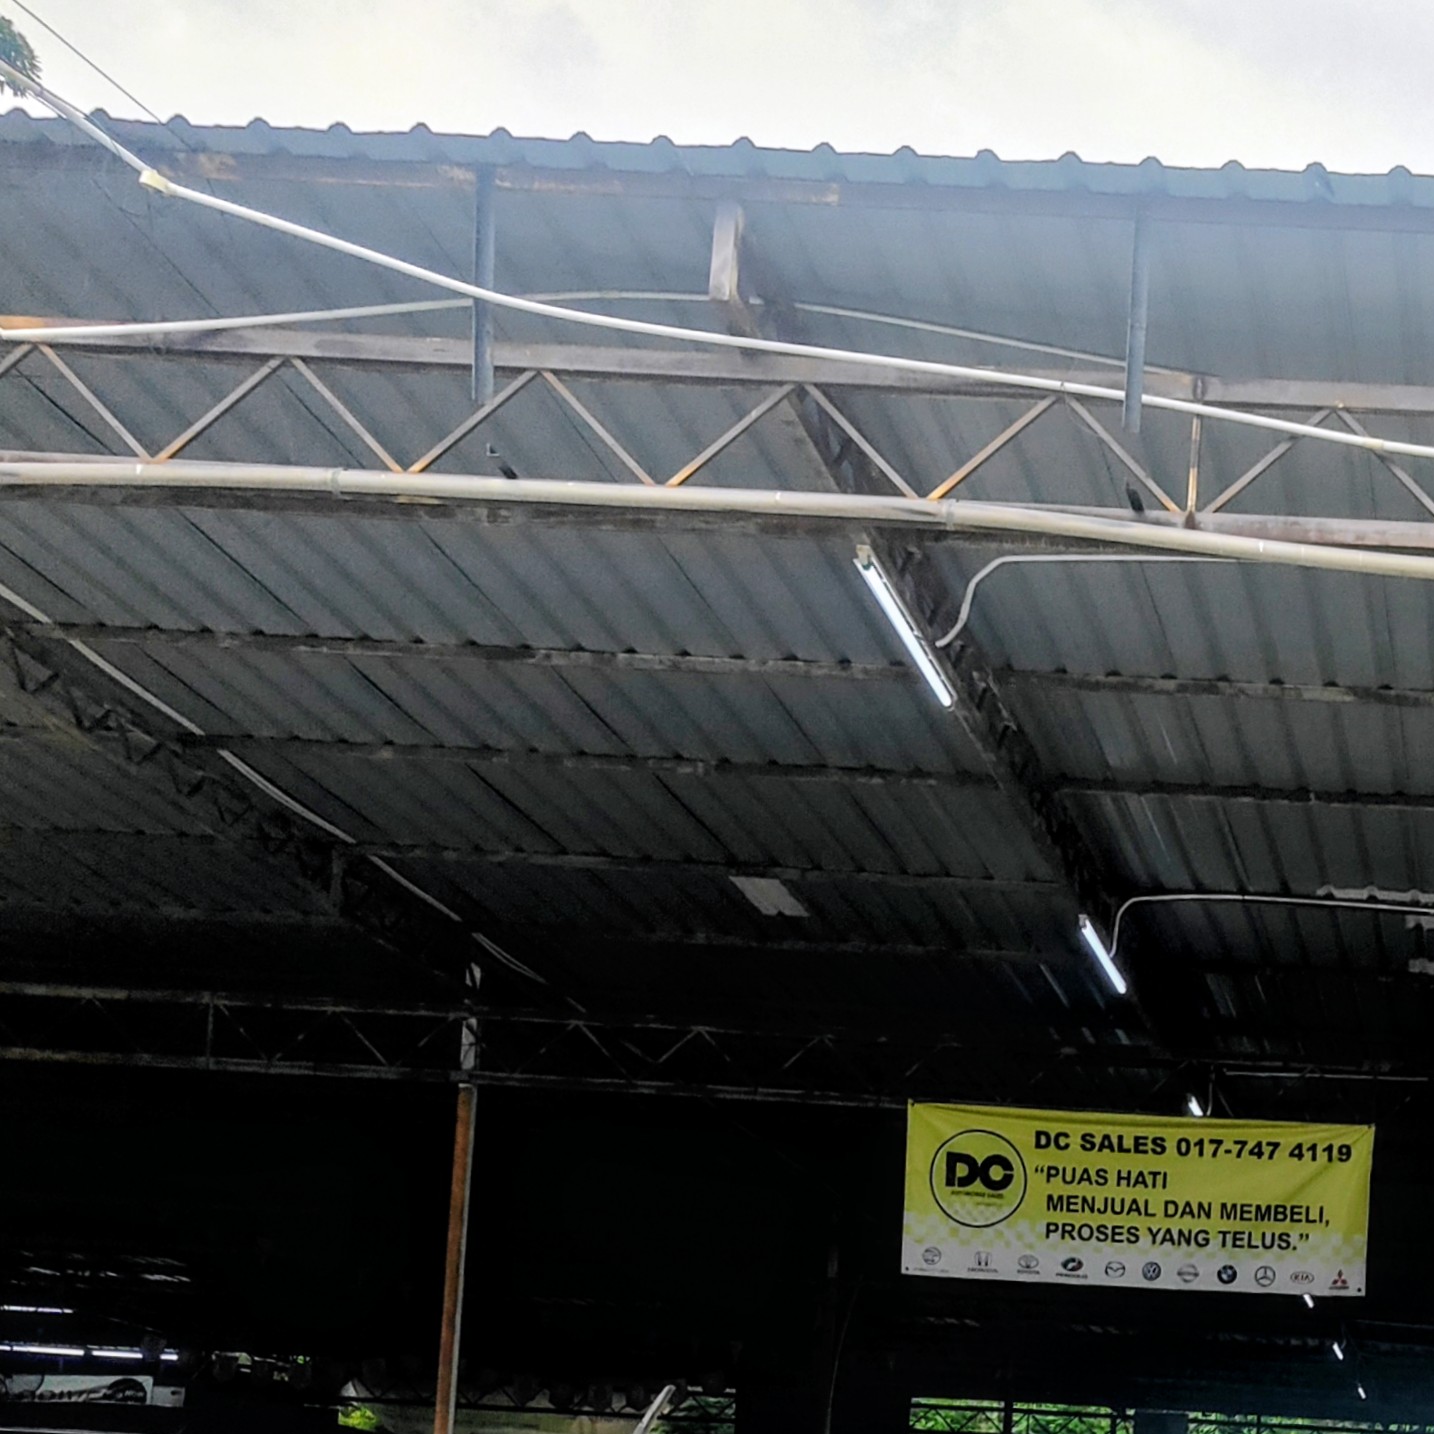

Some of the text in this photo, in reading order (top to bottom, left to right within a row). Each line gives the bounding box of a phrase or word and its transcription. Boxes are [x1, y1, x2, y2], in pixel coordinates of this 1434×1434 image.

[1034, 1130, 1352, 1163] DC SALES 017-747 4119
[945, 1151, 1014, 1191] DC
[1116, 1169, 1168, 1189] HATI
[1046, 1194, 1330, 1227] MENJUAL DAN MEMBELI,
[1045, 1222, 1140, 1244] PROSES
[1147, 1227, 1210, 1247] YANG
